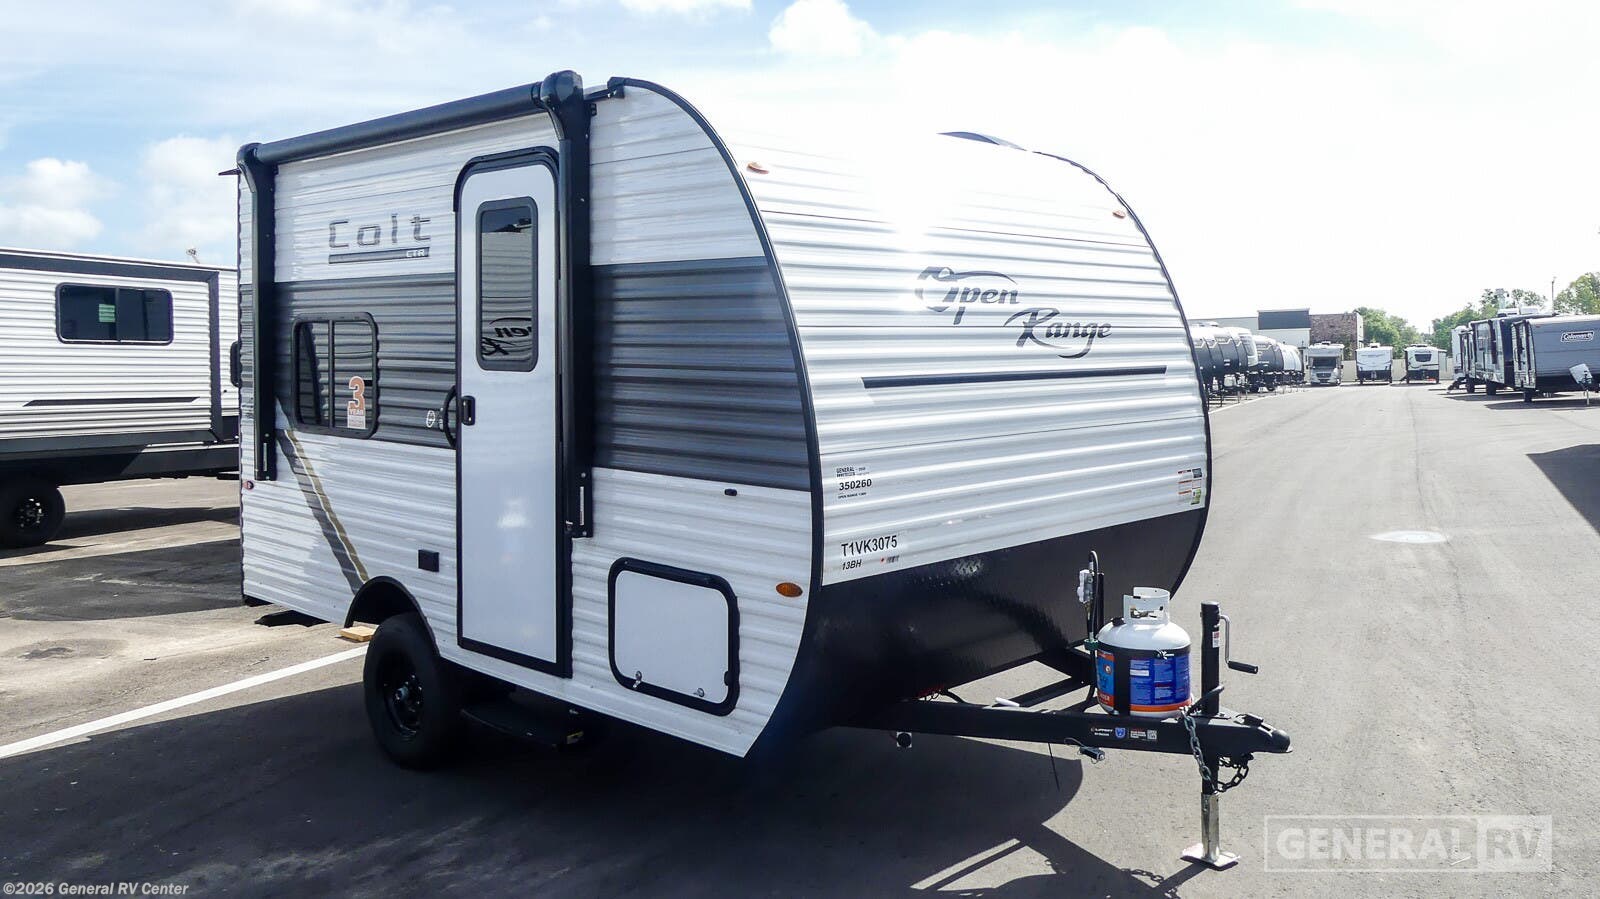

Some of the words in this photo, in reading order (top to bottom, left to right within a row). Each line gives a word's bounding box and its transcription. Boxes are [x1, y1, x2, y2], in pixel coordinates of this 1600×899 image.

[328, 213, 431, 248] Colt
[406, 249, 425, 258] CTR
[914, 266, 1018, 326] Open
[1003, 307, 1112, 359] Range
[348, 376, 365, 409] 3
[839, 478, 872, 491] 350260
[841, 535, 898, 557] T1VK3075
[842, 558, 862, 571] 13BH
